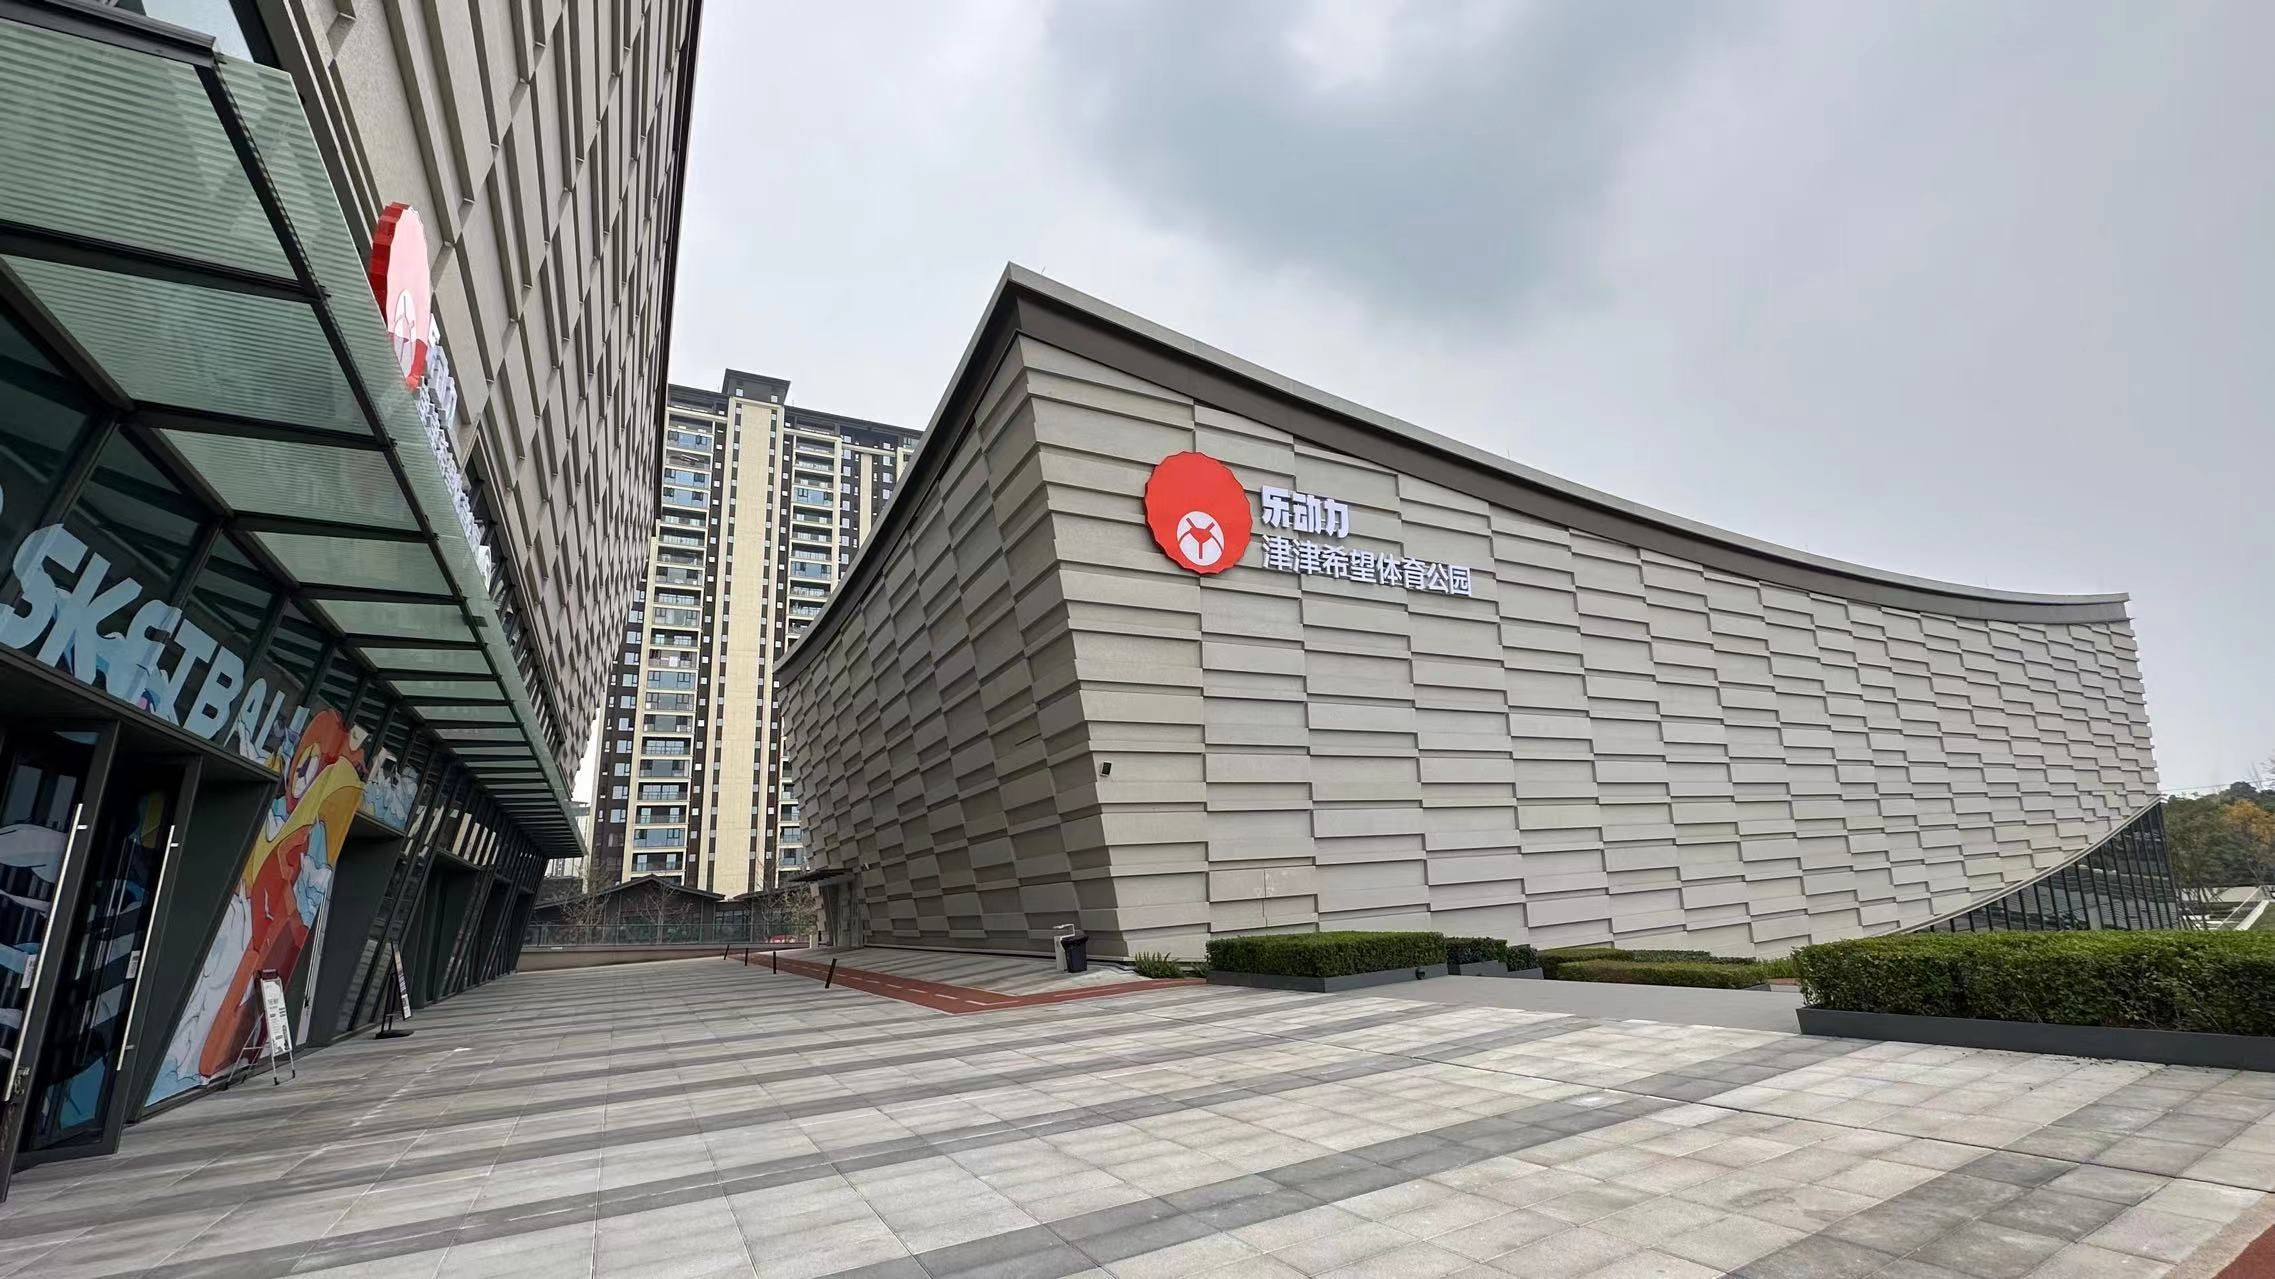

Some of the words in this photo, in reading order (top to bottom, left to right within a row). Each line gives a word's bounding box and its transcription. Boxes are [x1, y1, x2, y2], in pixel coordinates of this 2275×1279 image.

[1261, 485, 1349, 538] 乐动力
[1261, 534, 1472, 597] 津津希望体育公园
[0, 484, 310, 768] SKETBALL
